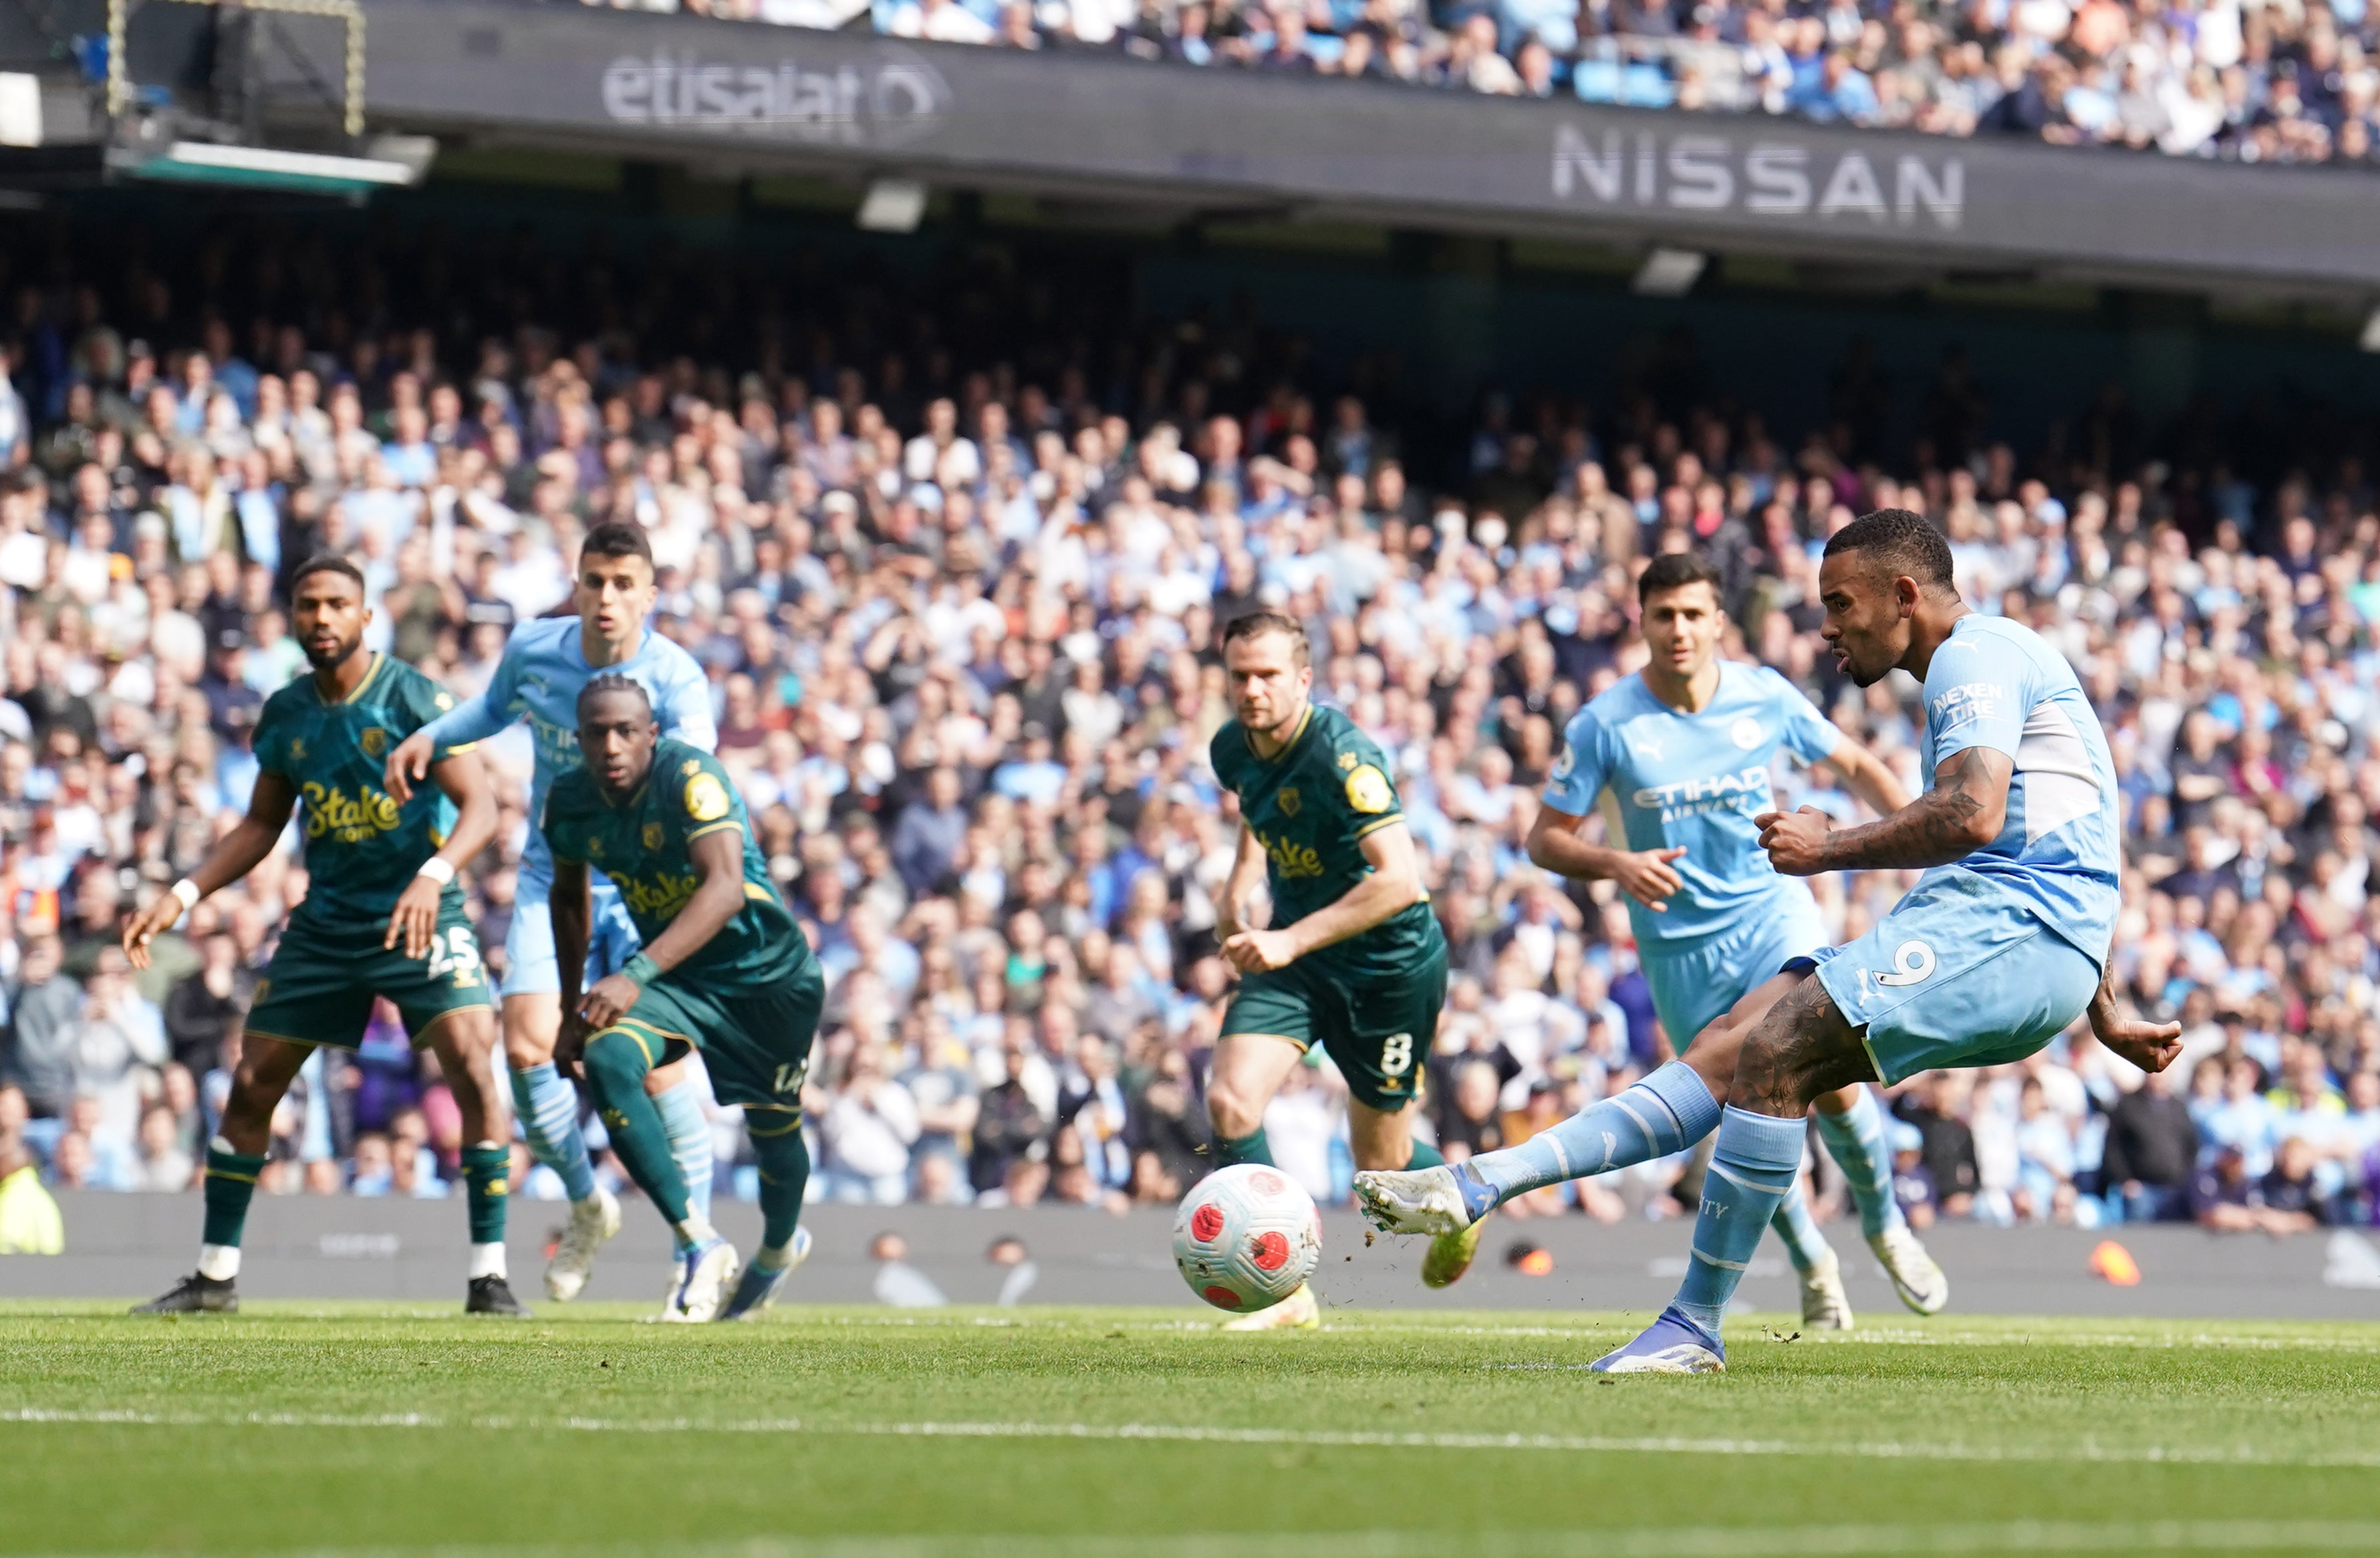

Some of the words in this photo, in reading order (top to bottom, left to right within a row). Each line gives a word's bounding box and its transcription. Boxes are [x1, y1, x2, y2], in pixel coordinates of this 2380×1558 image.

[603, 57, 861, 131] etisalat
[1551, 124, 1965, 229] NISSAN
[1933, 683, 2004, 714] NEXEN
[1946, 700, 1994, 723] TIRE
[303, 781, 400, 837] Stake
[1633, 765, 1767, 808] ETIHAD
[428, 926, 480, 981] 25
[1872, 940, 1937, 986] 9
[1380, 1033, 1413, 1077] 8
